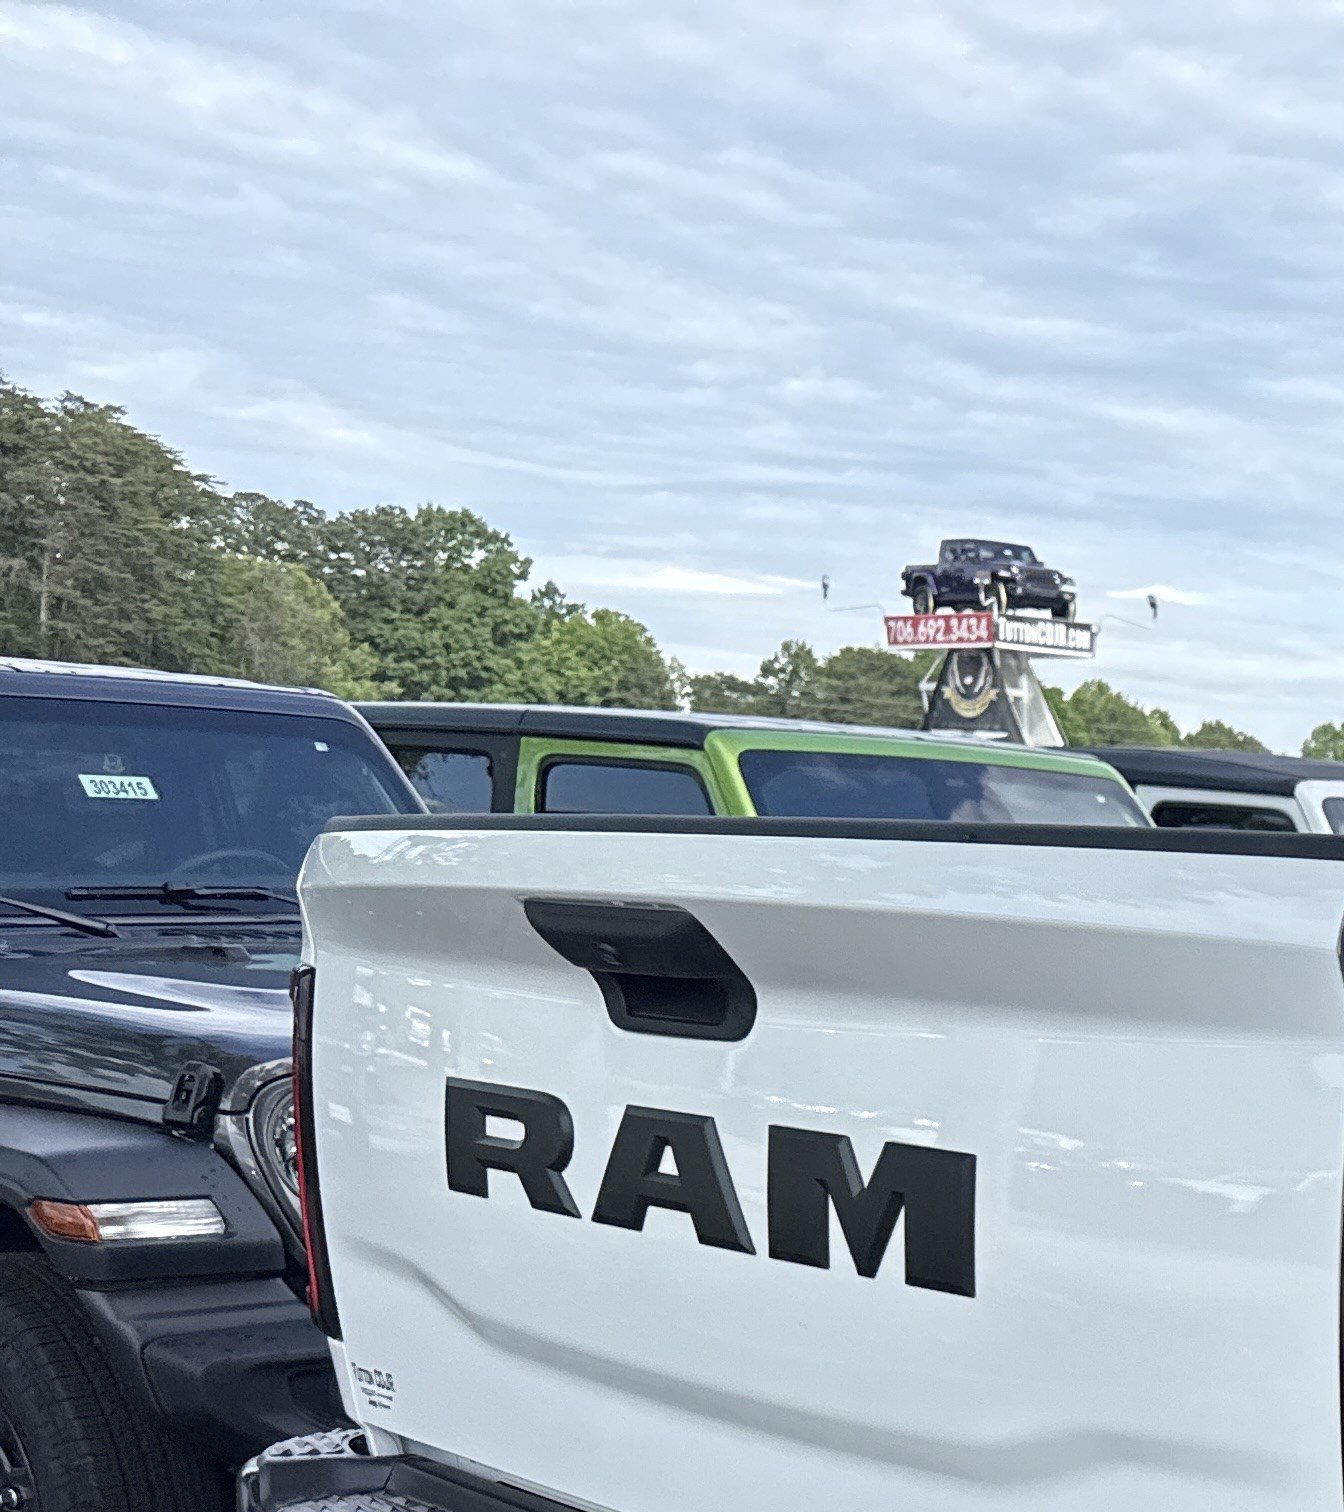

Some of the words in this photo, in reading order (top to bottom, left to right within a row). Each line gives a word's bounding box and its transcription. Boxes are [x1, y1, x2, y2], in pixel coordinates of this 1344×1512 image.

[888, 615, 989, 643] 706.692.3434
[90, 780, 147, 796] 303415
[445, 1076, 977, 1299] RAM
